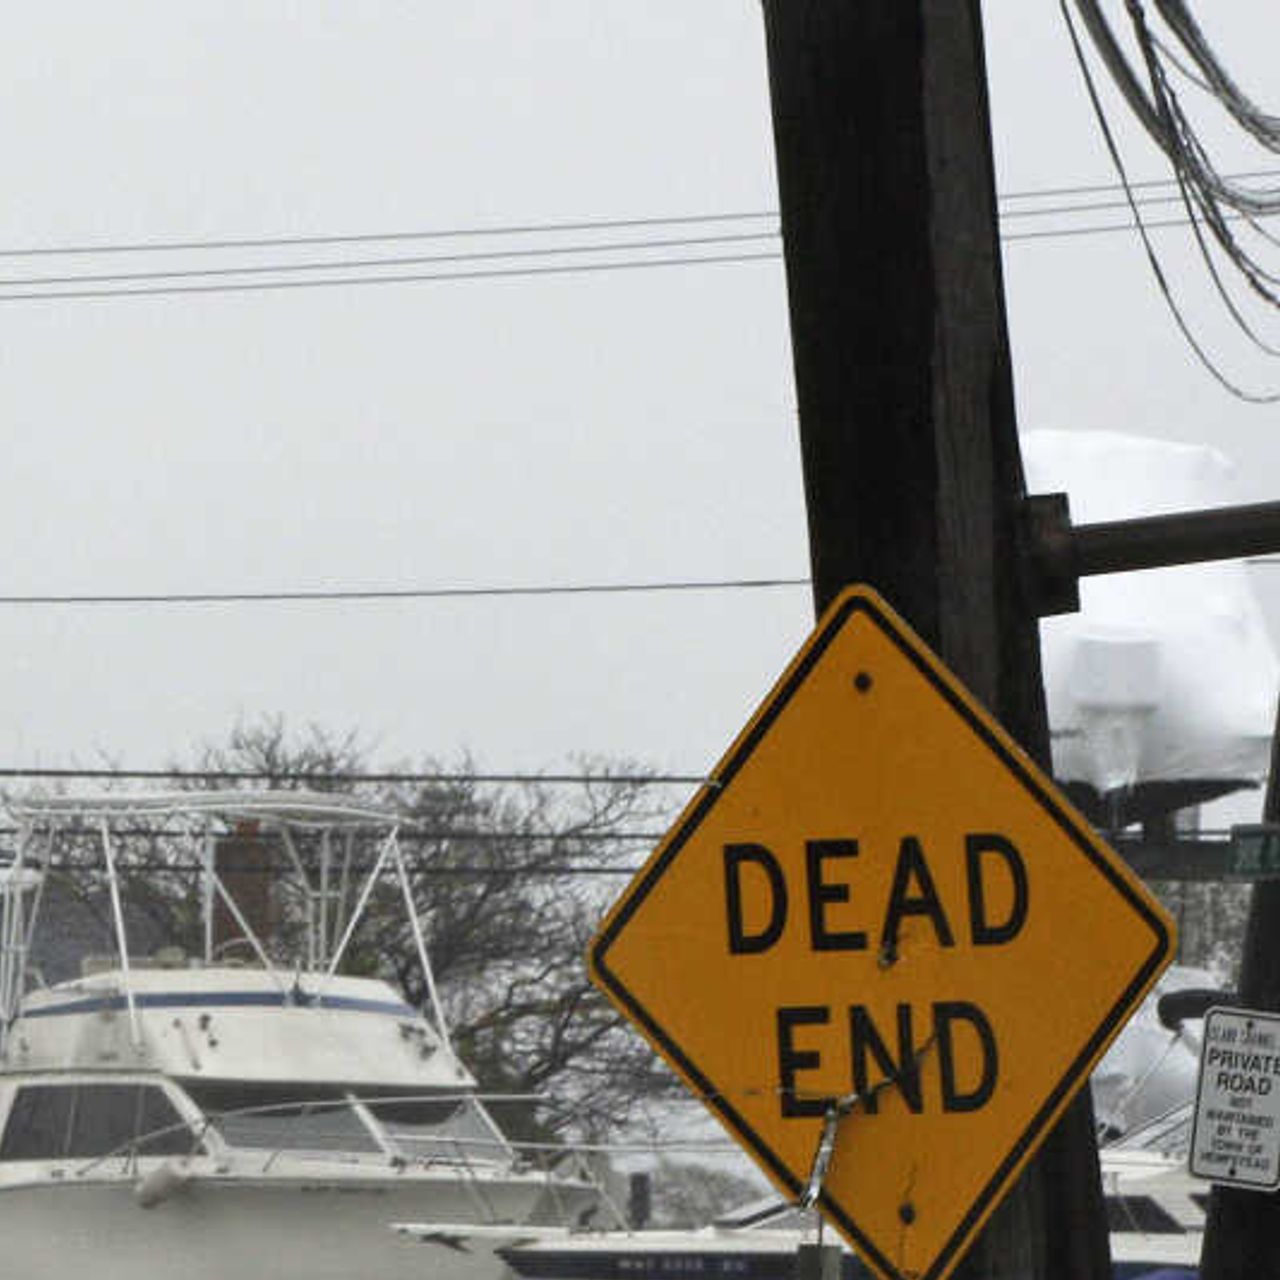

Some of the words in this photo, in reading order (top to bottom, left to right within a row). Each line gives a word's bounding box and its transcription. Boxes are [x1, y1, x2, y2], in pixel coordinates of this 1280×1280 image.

[723, 833, 1029, 957] DEAD
[777, 1001, 999, 1118] END
[1207, 1046, 1280, 1075] PRIVATE
[1217, 1071, 1272, 1096] ROAD
